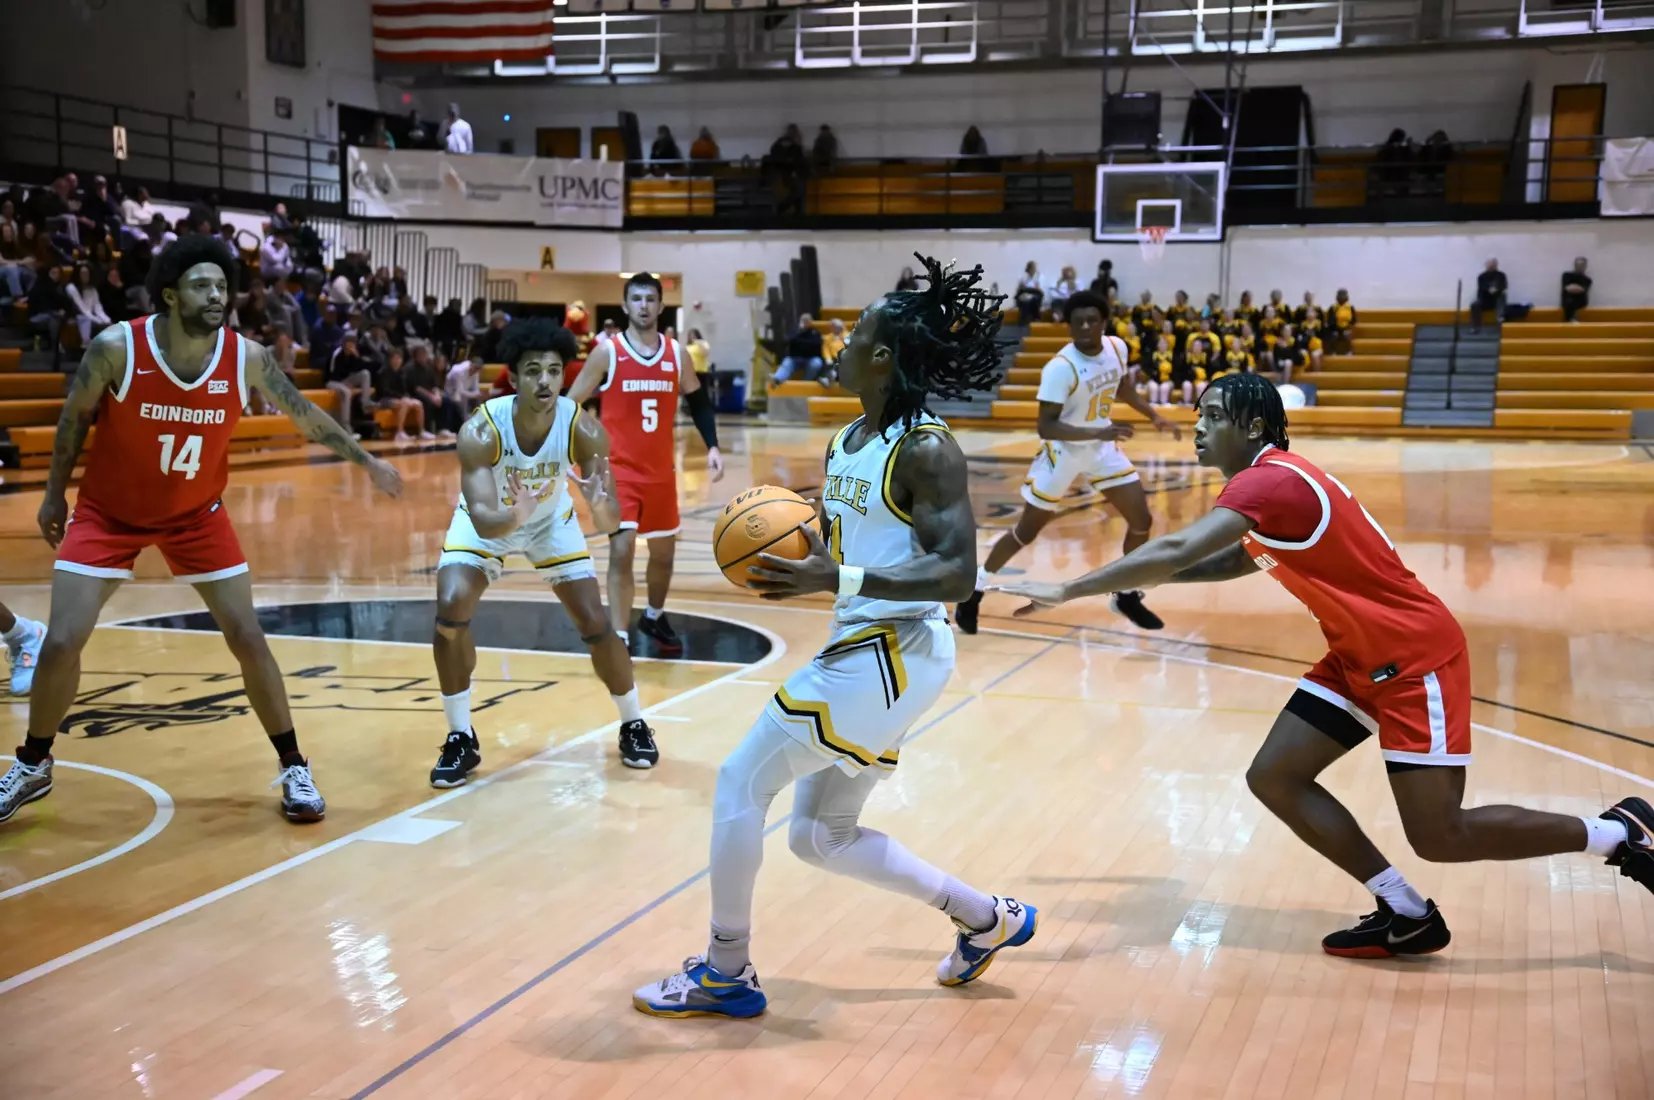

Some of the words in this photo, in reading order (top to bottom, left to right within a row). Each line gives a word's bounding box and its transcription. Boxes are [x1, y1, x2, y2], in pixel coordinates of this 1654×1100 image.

[115, 128, 125, 156] A
[538, 175, 620, 201] UPMC
[541, 246, 554, 270] A
[622, 379, 673, 393] EDINBORO
[140, 402, 226, 424] EDINBORO
[641, 398, 659, 433] 5
[1085, 387, 1115, 422] 15
[157, 433, 204, 480] 14
[725, 488, 764, 516] EVO
[825, 474, 872, 517] ILLE
